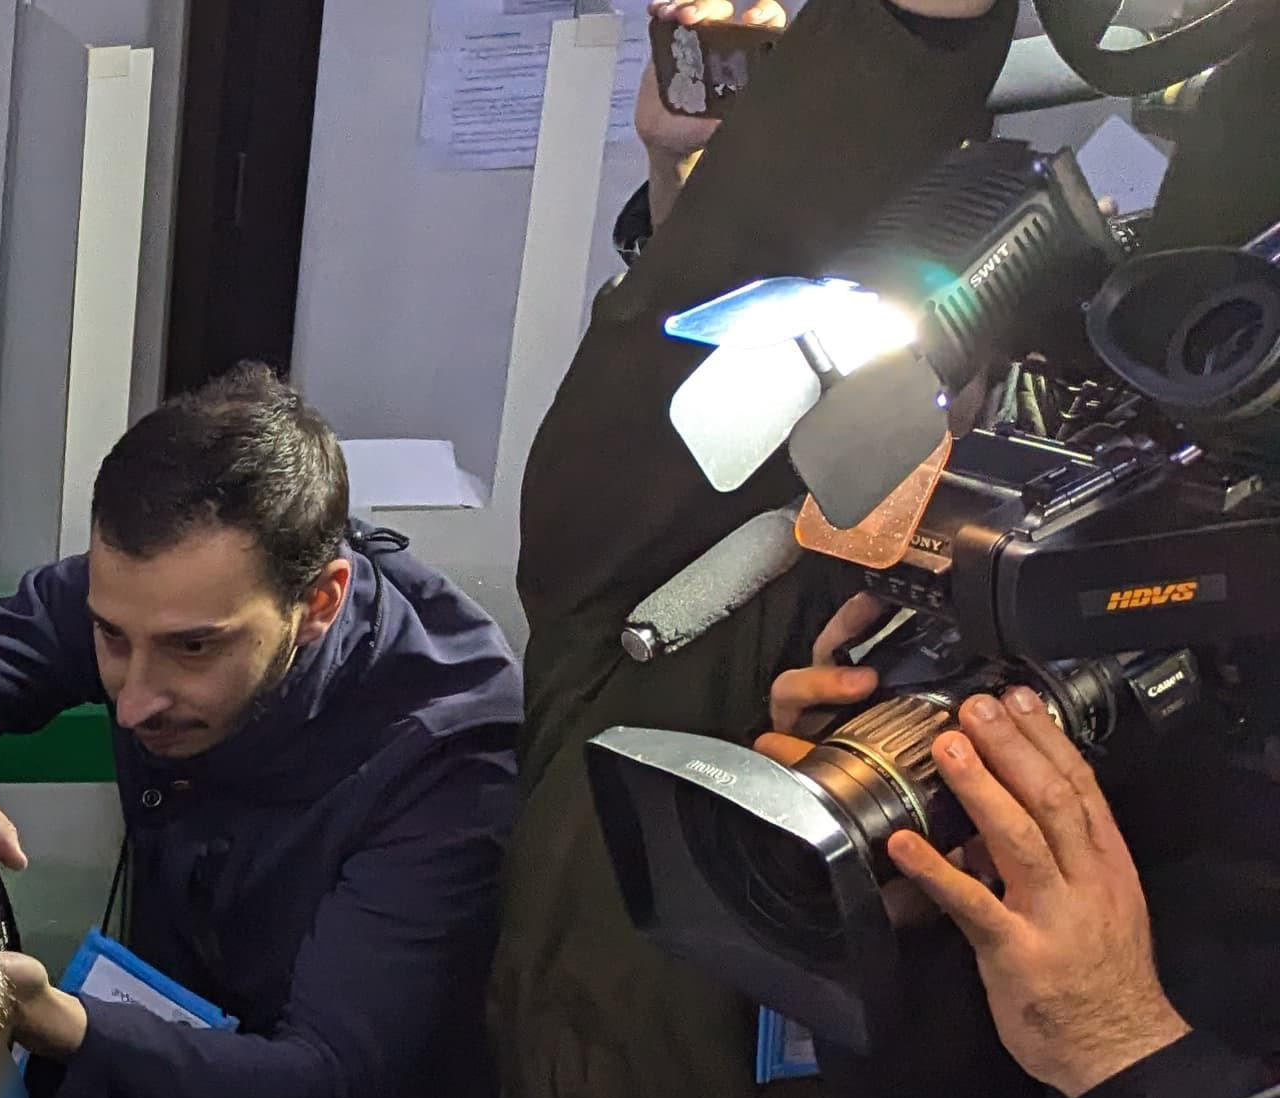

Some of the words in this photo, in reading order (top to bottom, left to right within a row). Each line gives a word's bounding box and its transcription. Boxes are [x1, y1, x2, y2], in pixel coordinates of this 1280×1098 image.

[970, 242, 1009, 288] SWIT
[911, 535, 943, 551] ONY
[1107, 582, 1198, 610] HDVS
[1147, 671, 1185, 698] Canon
